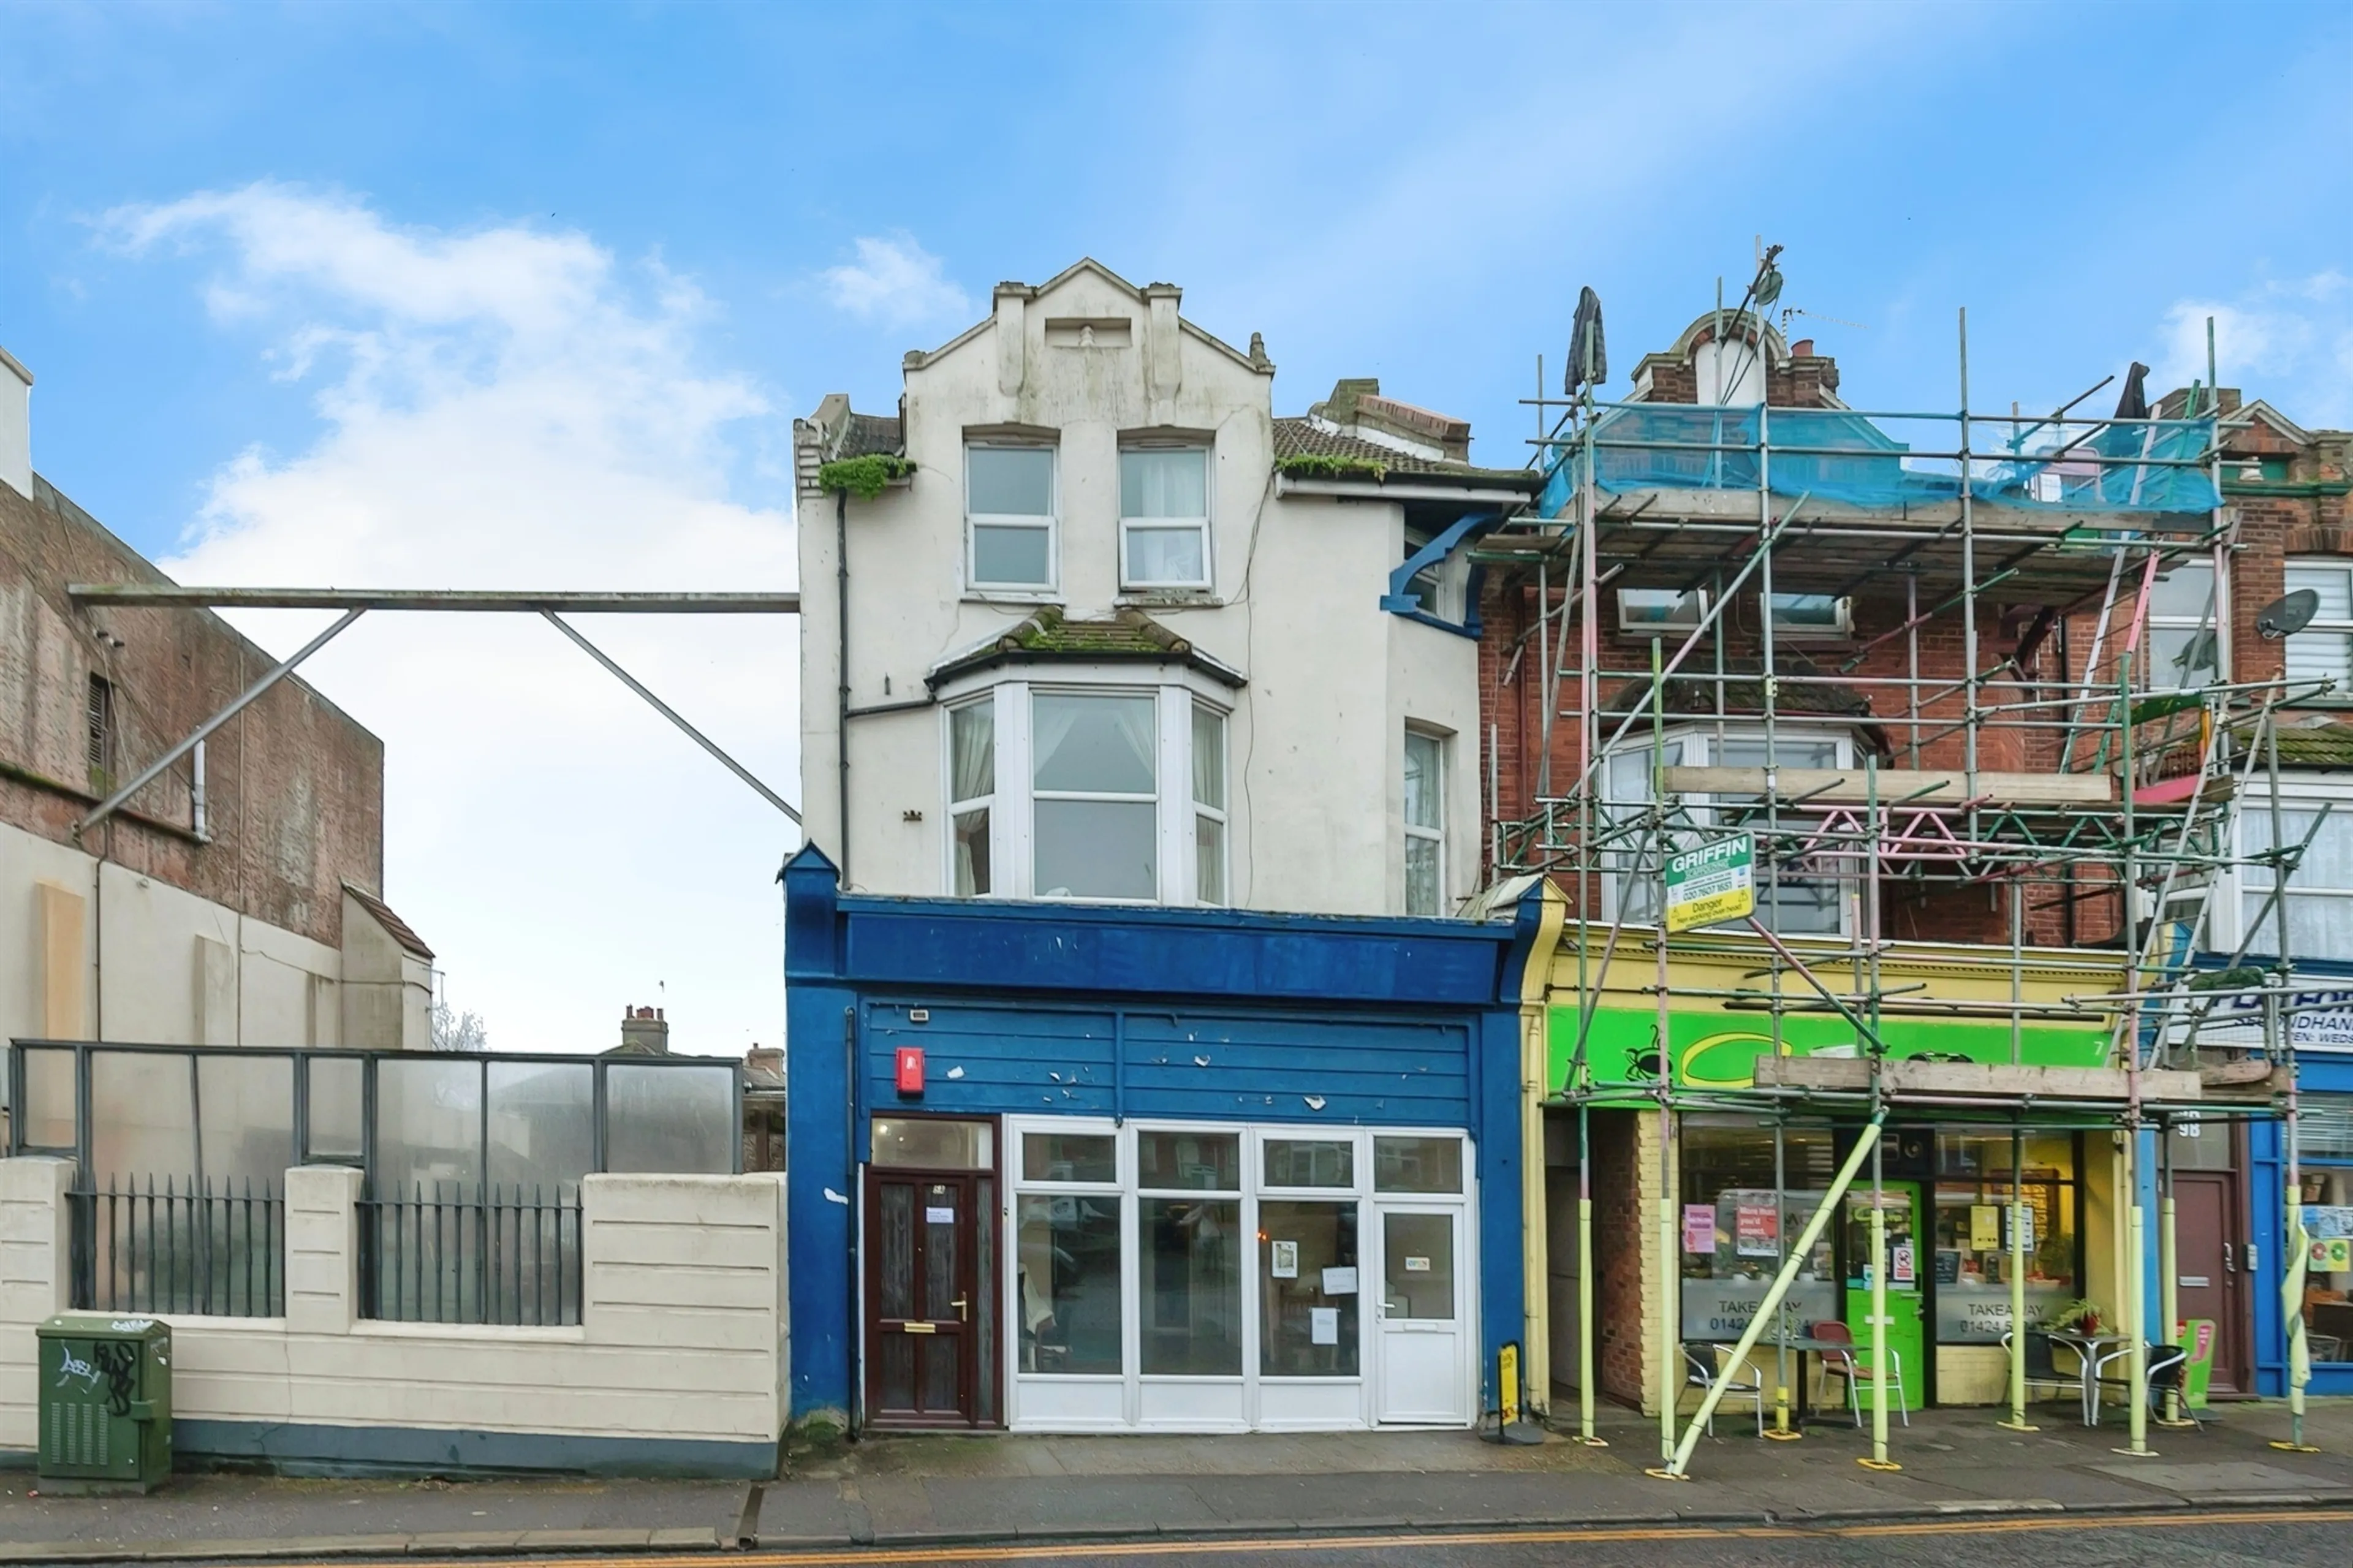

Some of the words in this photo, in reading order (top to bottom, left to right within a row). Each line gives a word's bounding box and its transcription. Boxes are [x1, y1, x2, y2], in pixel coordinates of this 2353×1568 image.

[1672, 836, 1748, 873] GRIFFIN
[1692, 898, 1723, 913] Danger
[2094, 1041, 2104, 1056] 7
[1719, 1300, 1802, 1313] TAKEAY
[1968, 1303, 2045, 1317] TAKEAAY
